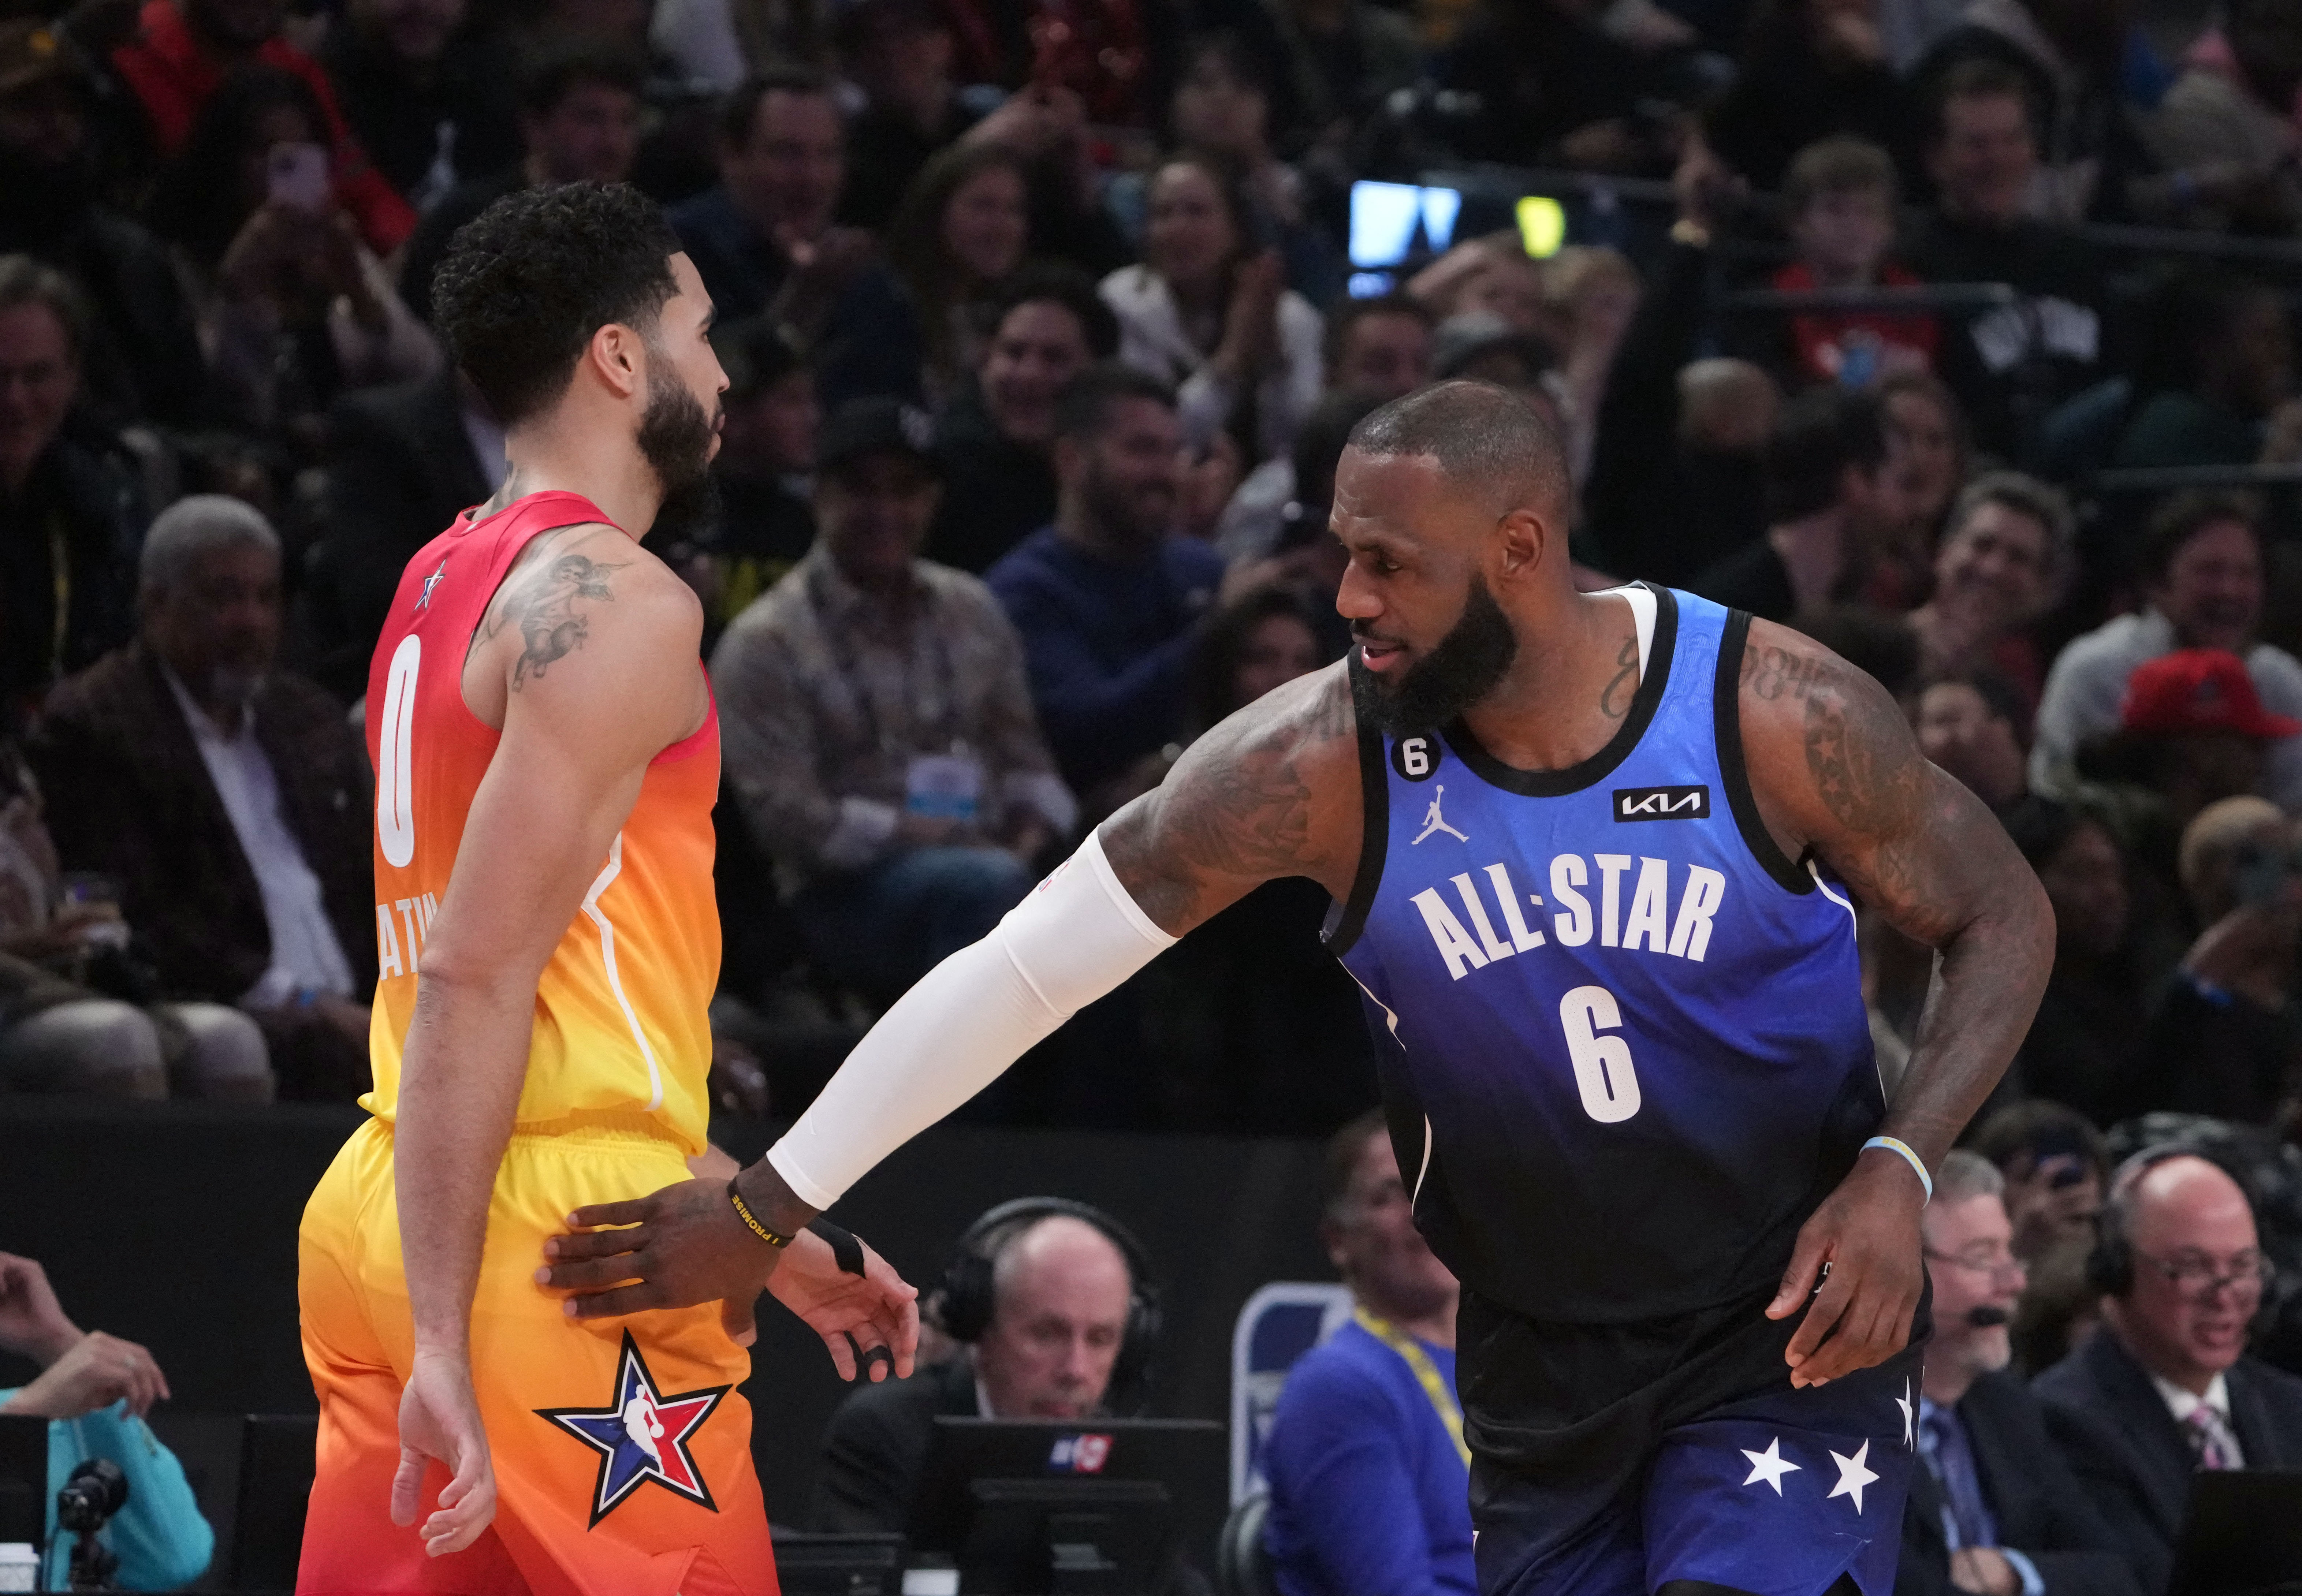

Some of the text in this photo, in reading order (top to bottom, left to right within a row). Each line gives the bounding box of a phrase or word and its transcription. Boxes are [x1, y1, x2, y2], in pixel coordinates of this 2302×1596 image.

[377, 634, 421, 868] 0
[1403, 738, 1428, 775] 6
[1622, 792, 1701, 815] KIA
[1559, 985, 1642, 1123] 6
[731, 1194, 772, 1241] PROMISE
